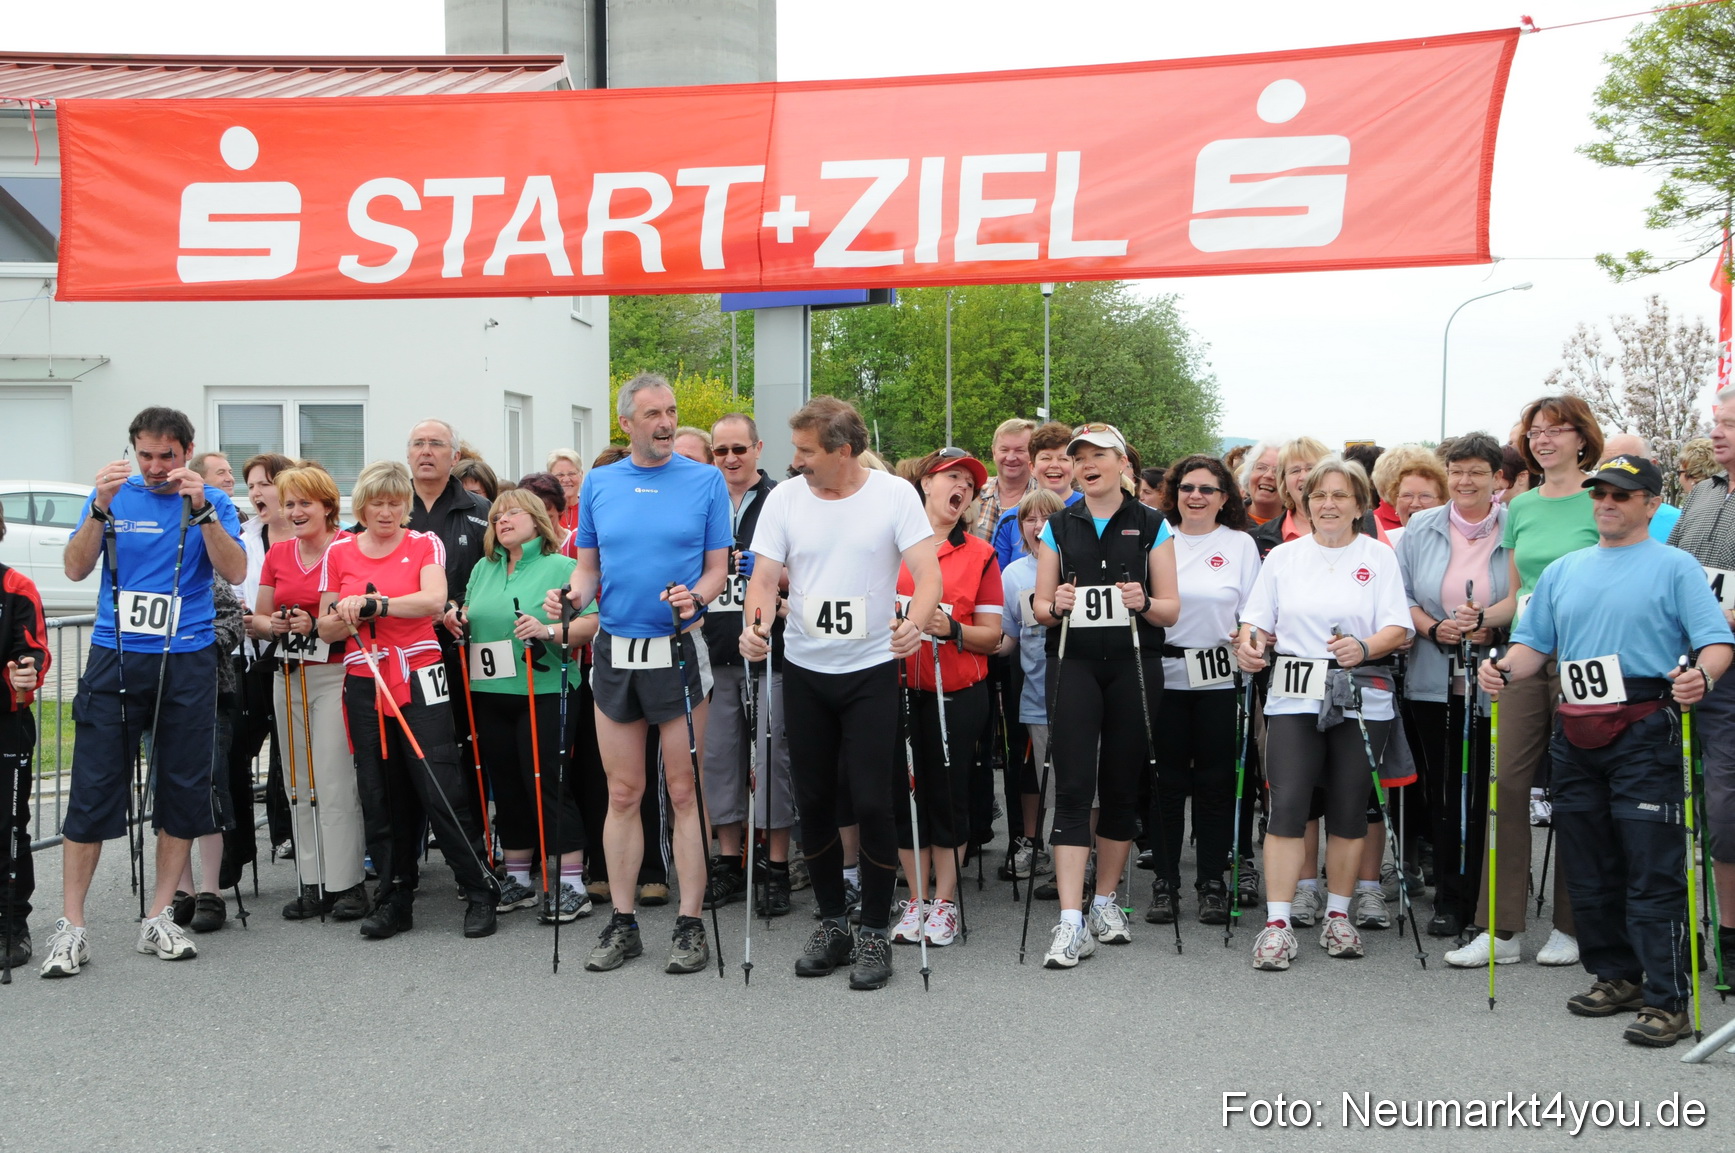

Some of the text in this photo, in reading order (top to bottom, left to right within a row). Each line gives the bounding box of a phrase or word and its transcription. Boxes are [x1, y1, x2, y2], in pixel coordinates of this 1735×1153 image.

[130, 595, 169, 629] 50
[816, 601, 853, 635] 45
[1086, 588, 1113, 621] 91
[480, 647, 496, 677] 9
[1195, 646, 1231, 680] 118
[1284, 660, 1314, 693] 117
[428, 666, 449, 698] 12
[1568, 660, 1608, 700] 89
